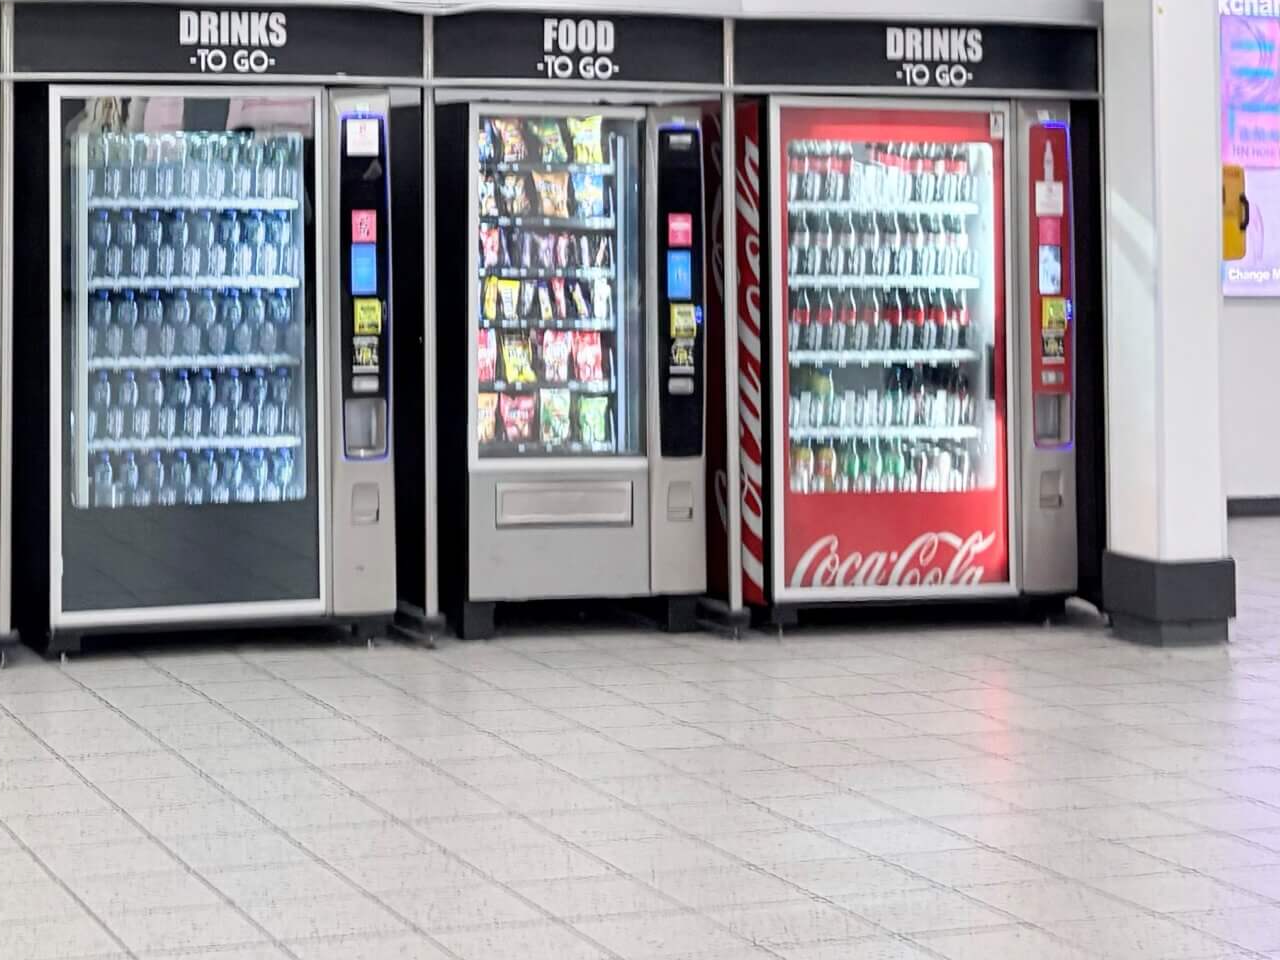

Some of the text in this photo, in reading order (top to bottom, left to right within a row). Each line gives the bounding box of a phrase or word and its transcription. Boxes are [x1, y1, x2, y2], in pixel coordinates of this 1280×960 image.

[179, 10, 288, 46] DRINKS
[543, 18, 616, 54] FOOD
[886, 27, 983, 63] DRINKS
